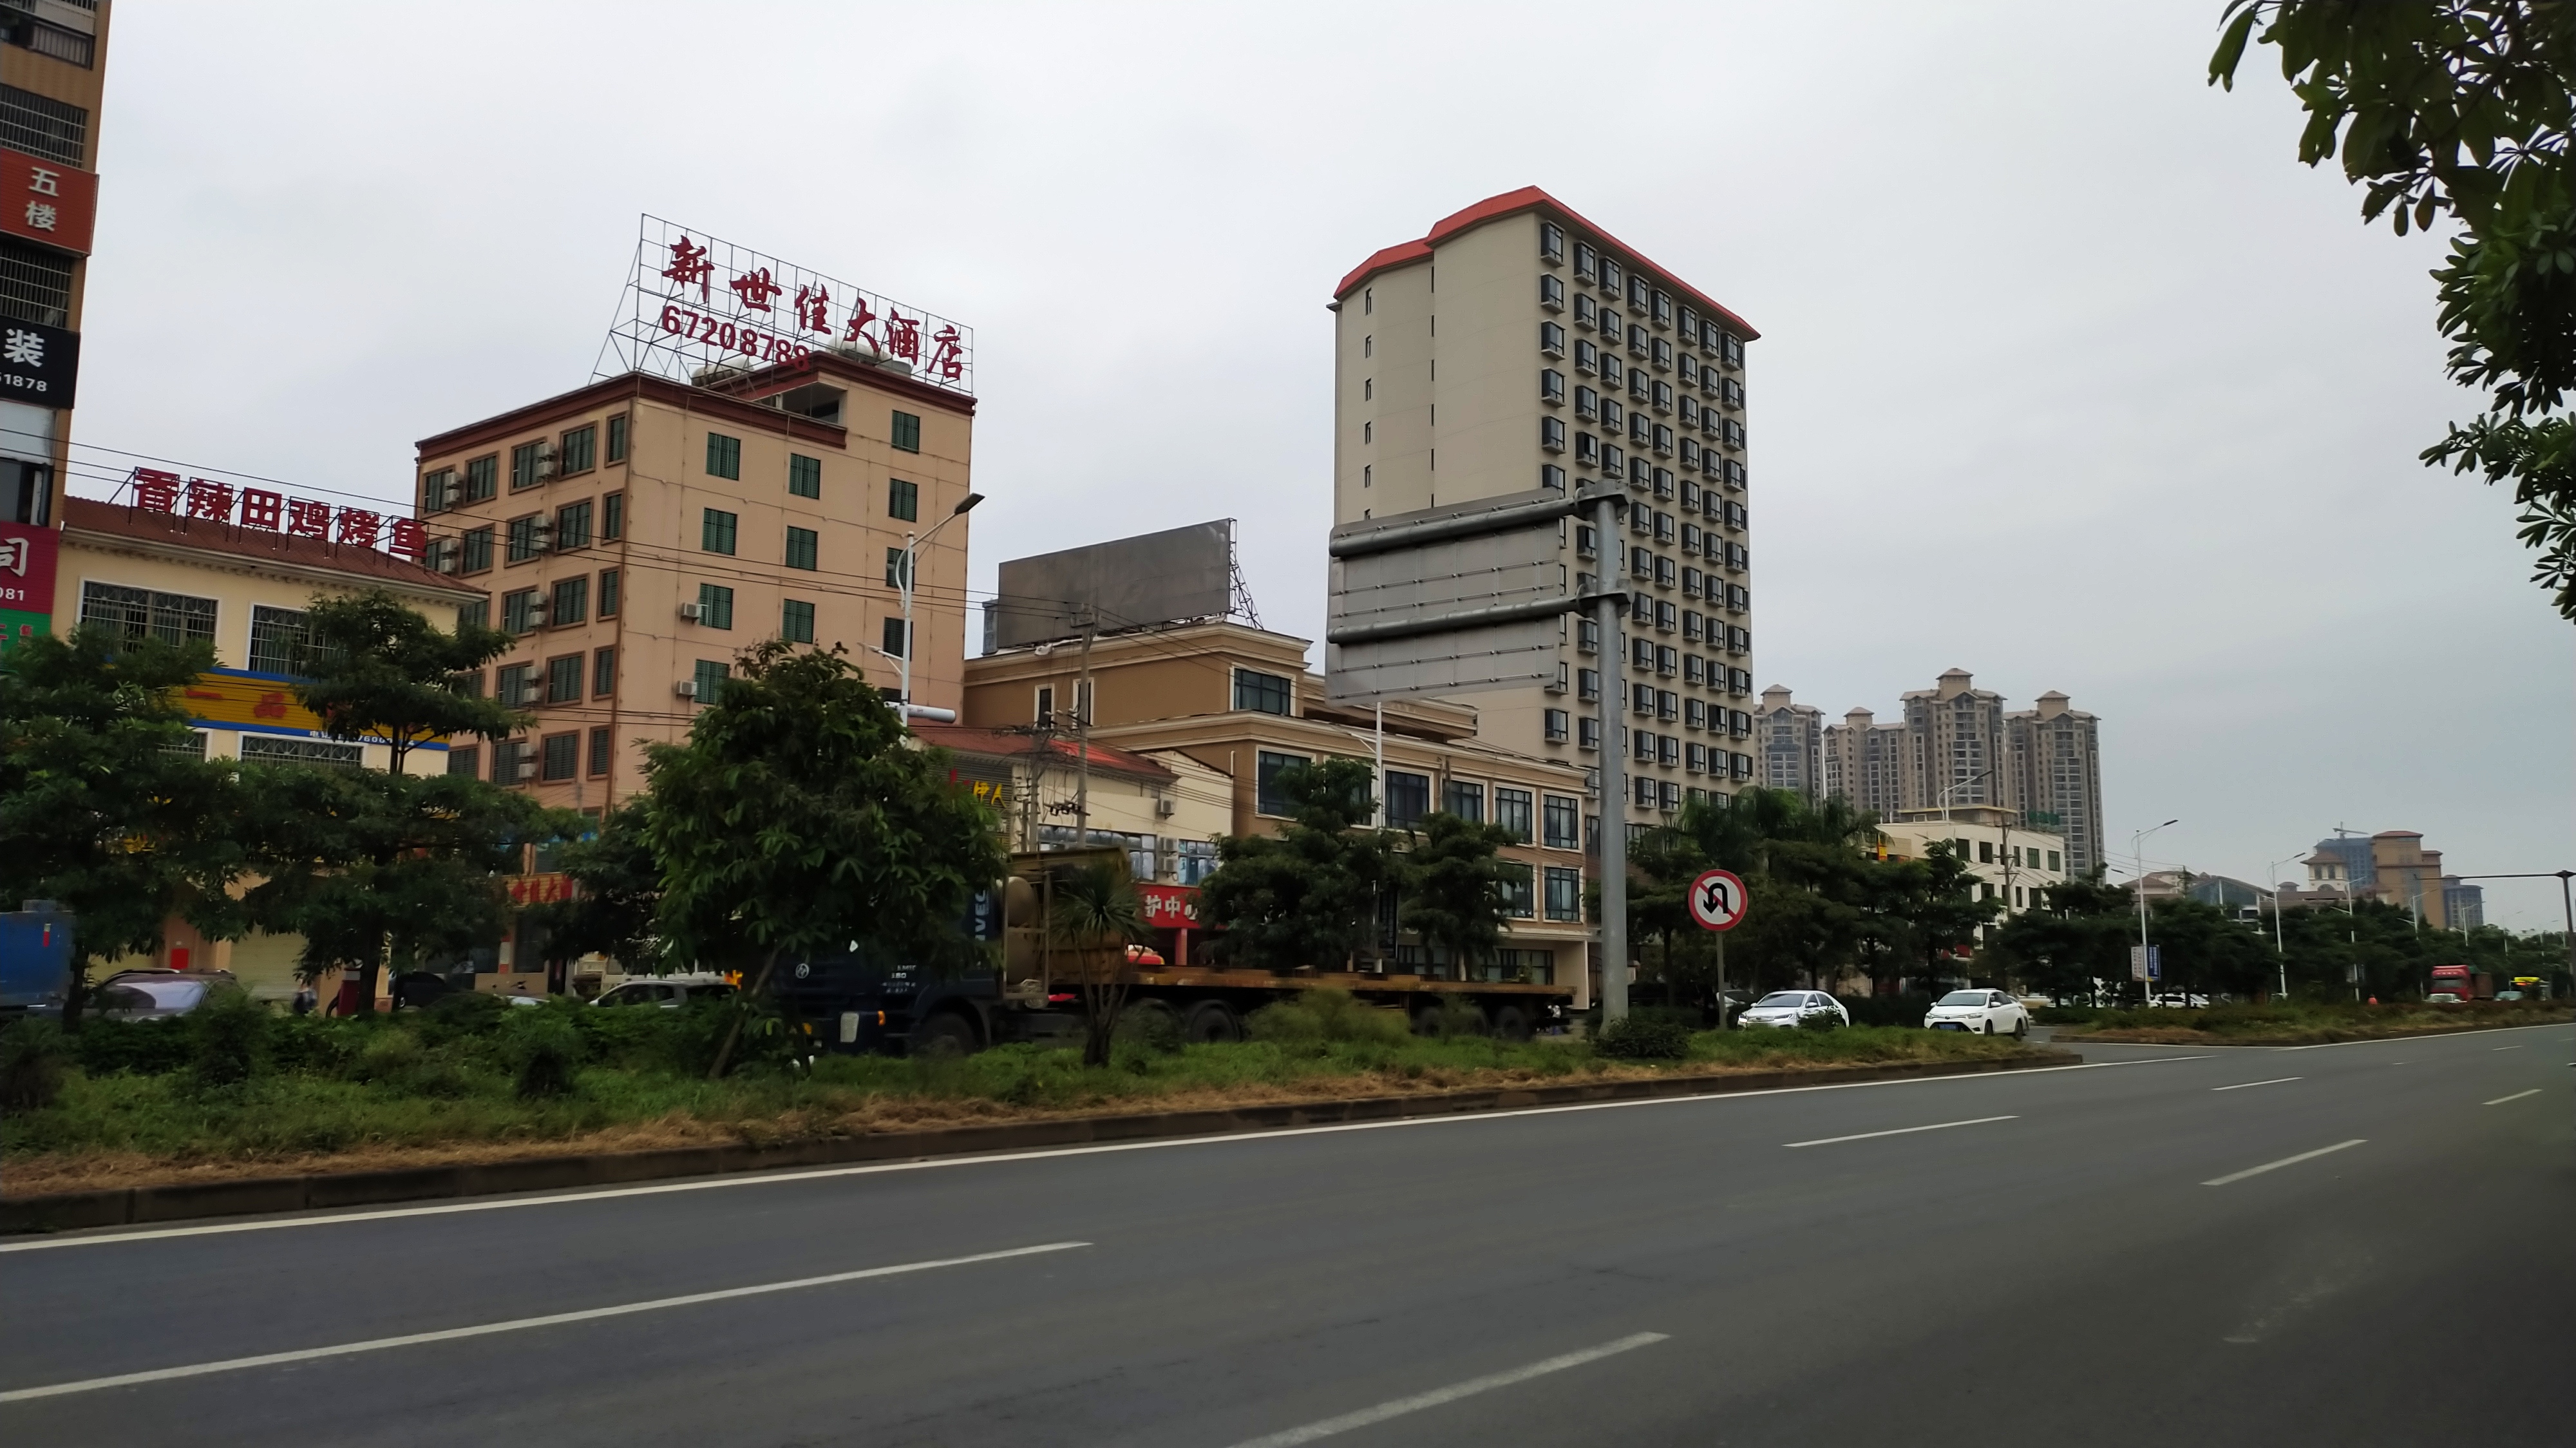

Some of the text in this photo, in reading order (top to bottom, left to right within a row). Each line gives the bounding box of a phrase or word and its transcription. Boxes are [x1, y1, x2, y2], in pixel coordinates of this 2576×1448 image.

[26, 166, 61, 233] 五楼
[661, 234, 963, 381] 新世佳大酒店
[661, 305, 810, 372] 67208788
[3, 328, 44, 367] 装
[0, 372, 48, 392] 1878
[133, 467, 428, 558] 香辣田鸡烤鱼
